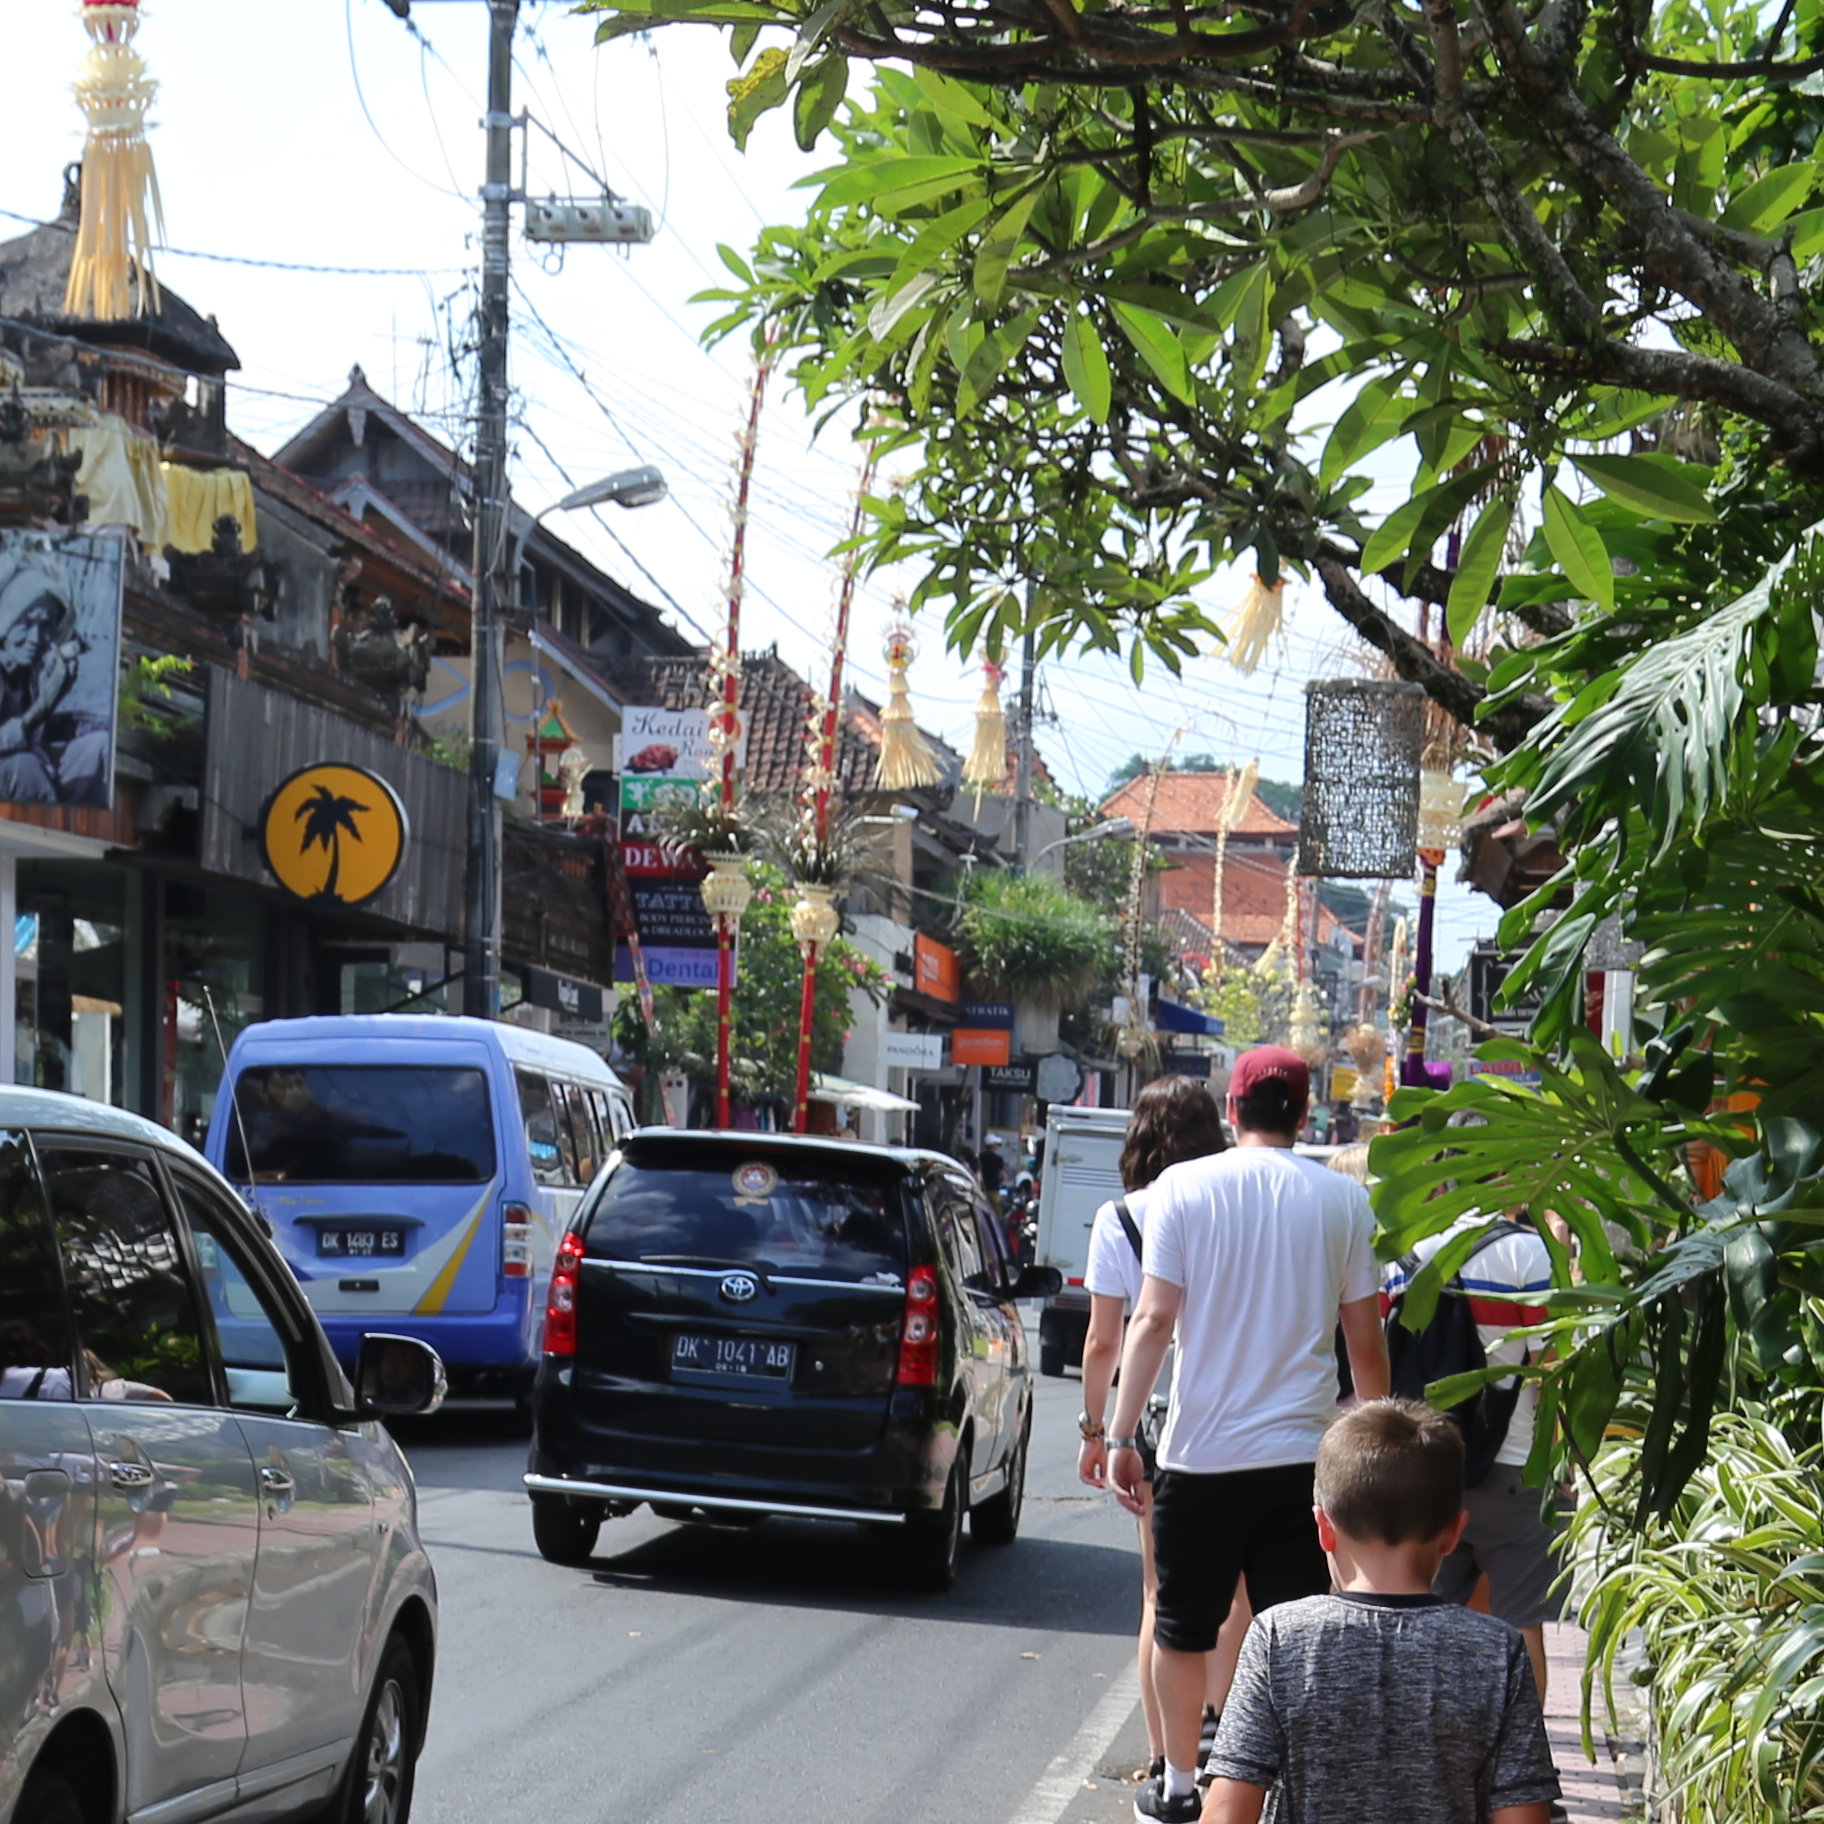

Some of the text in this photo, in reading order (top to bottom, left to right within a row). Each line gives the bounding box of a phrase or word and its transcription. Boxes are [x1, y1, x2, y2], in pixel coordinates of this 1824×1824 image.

[631, 711, 703, 738] Kedai
[648, 958, 718, 980] Dental
[990, 1067, 1031, 1079] TAKSU
[321, 1232, 339, 1249] DK
[381, 1231, 398, 1249] ES
[676, 1336, 790, 1367] DK 1041 AB
